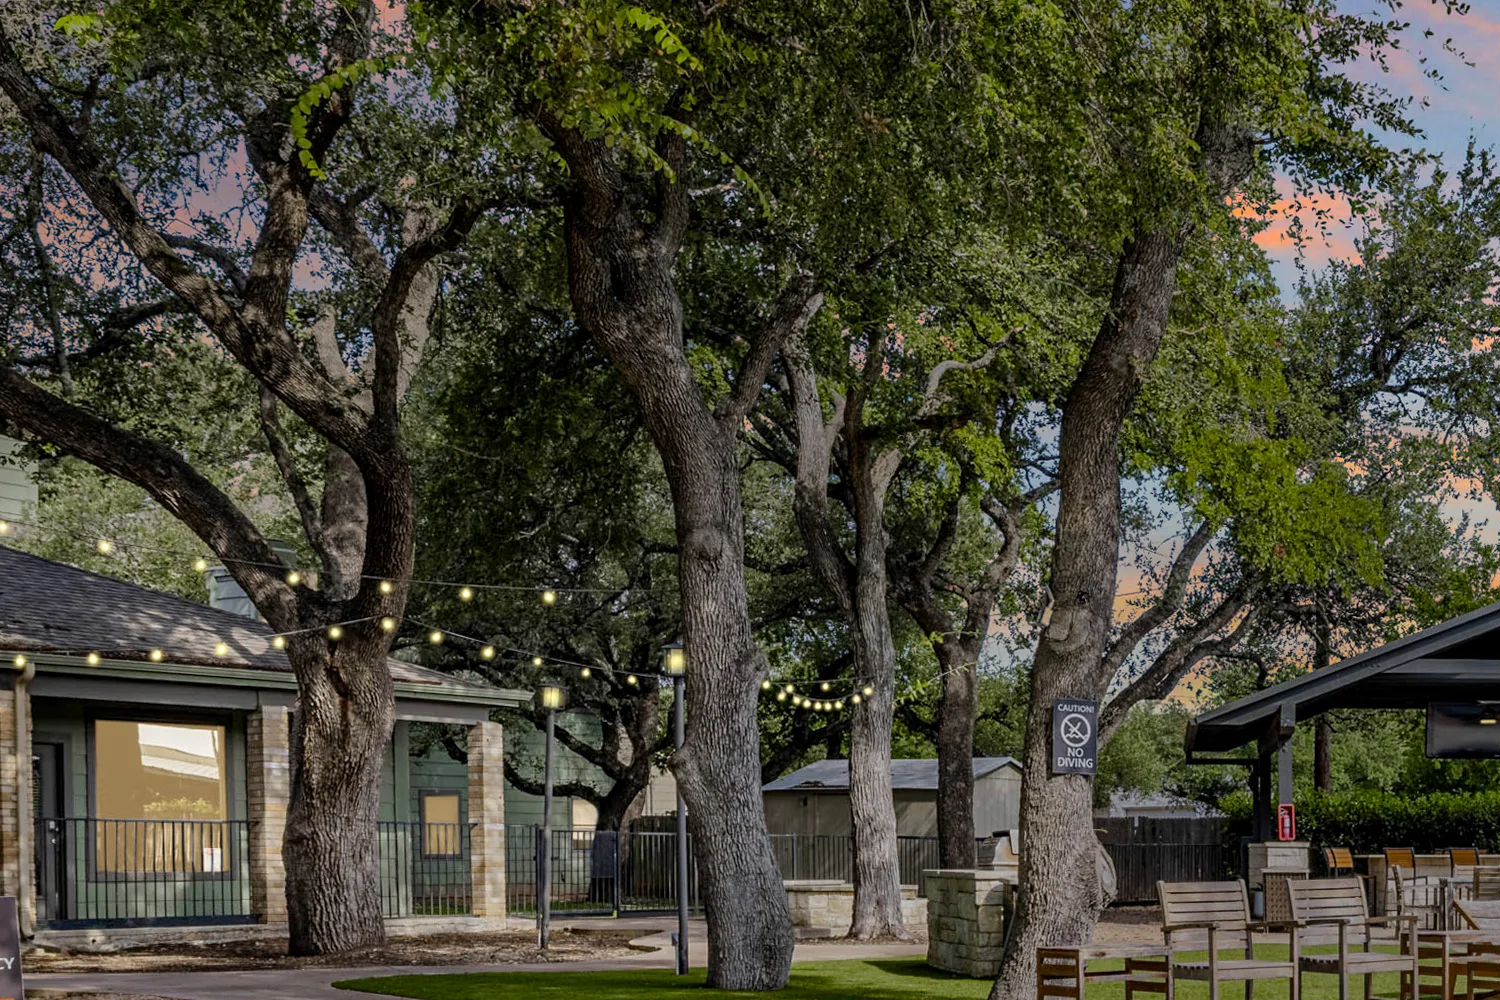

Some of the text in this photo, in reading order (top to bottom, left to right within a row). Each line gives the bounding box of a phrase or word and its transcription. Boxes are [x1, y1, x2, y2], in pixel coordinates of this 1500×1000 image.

[1057, 703, 1095, 714] CAUTION!
[1067, 747, 1084, 758] NO
[1057, 757, 1094, 768] DIVING
